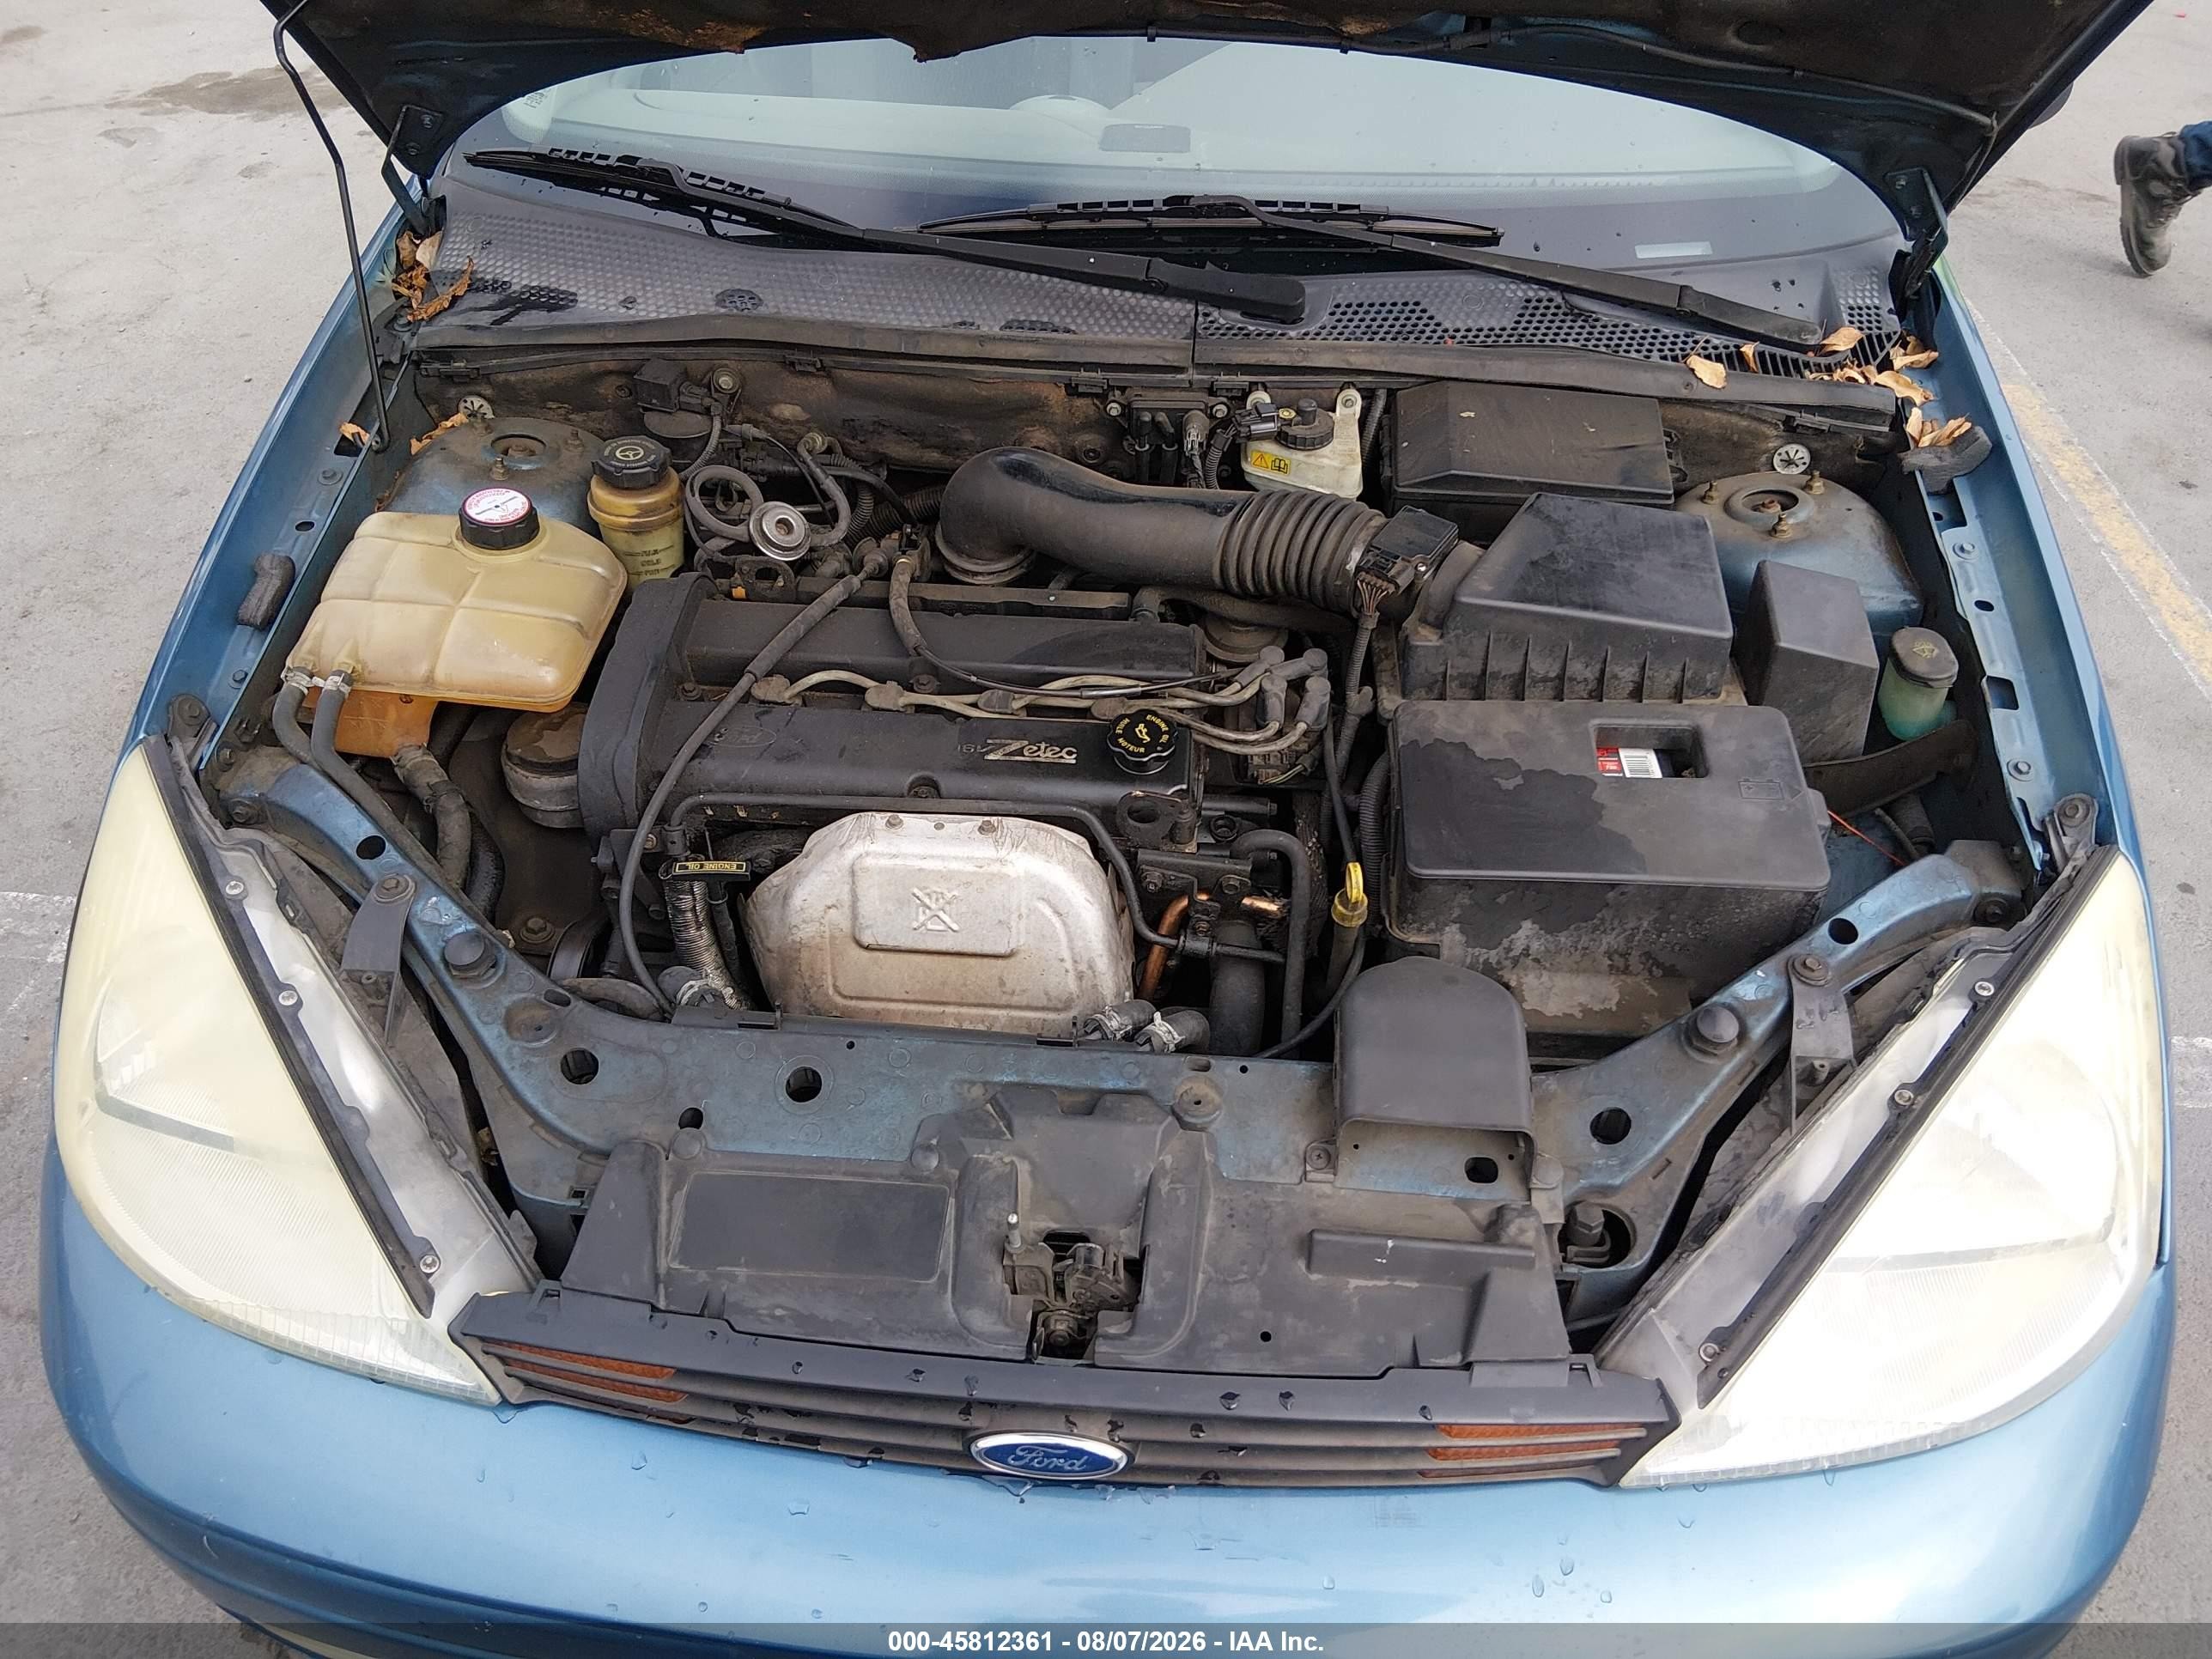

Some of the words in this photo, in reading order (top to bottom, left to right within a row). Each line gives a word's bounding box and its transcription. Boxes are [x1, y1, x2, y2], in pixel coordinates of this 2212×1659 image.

[1146, 714, 1170, 732] ENGINE
[1159, 734, 1170, 744] OIL
[984, 738, 1078, 764] Zetec
[1116, 737, 1146, 753] MOTEUR
[1006, 1445, 1088, 1470] Ford
